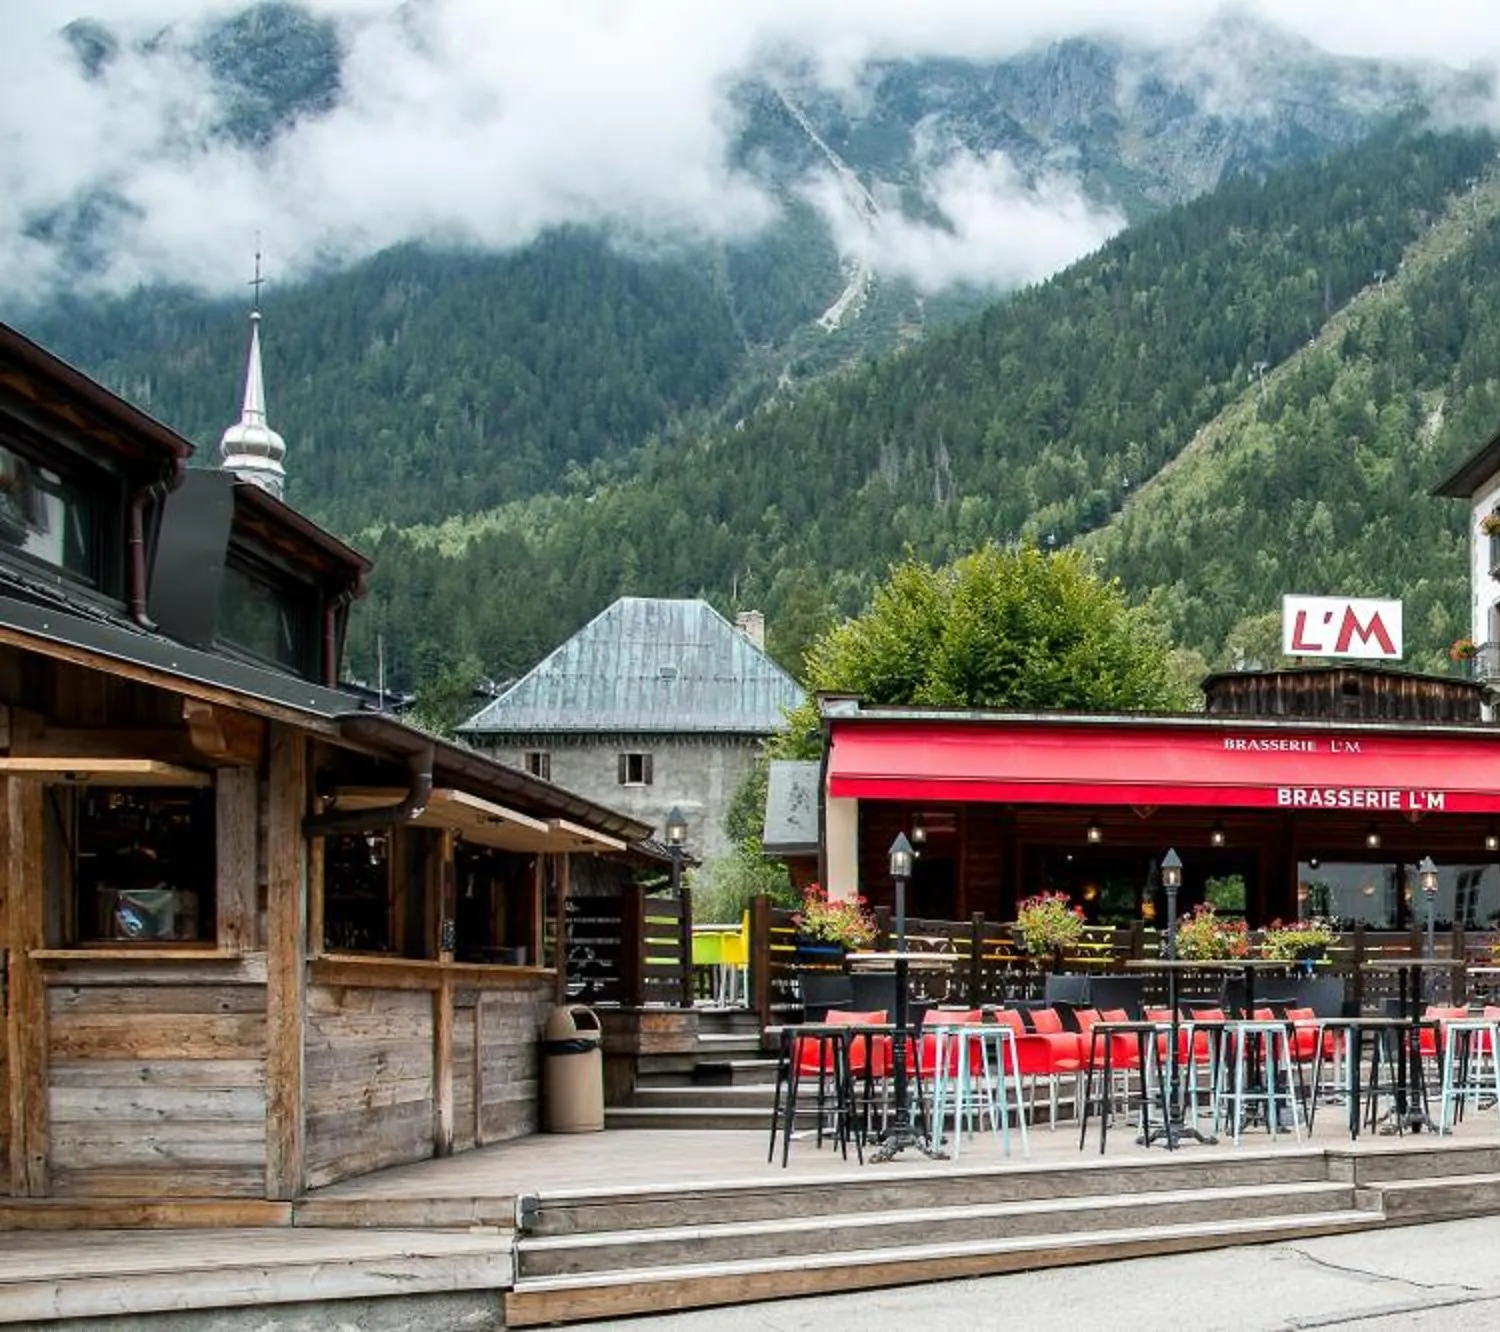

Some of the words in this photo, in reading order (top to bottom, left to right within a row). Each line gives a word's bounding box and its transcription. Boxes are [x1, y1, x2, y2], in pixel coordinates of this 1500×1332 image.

[1291, 603, 1397, 654] L'M
[1224, 738, 1316, 751] BRASSERIE
[1330, 739, 1362, 753] L'M
[1277, 788, 1401, 809] BRASSERIE
[1409, 791, 1445, 809] L'M
